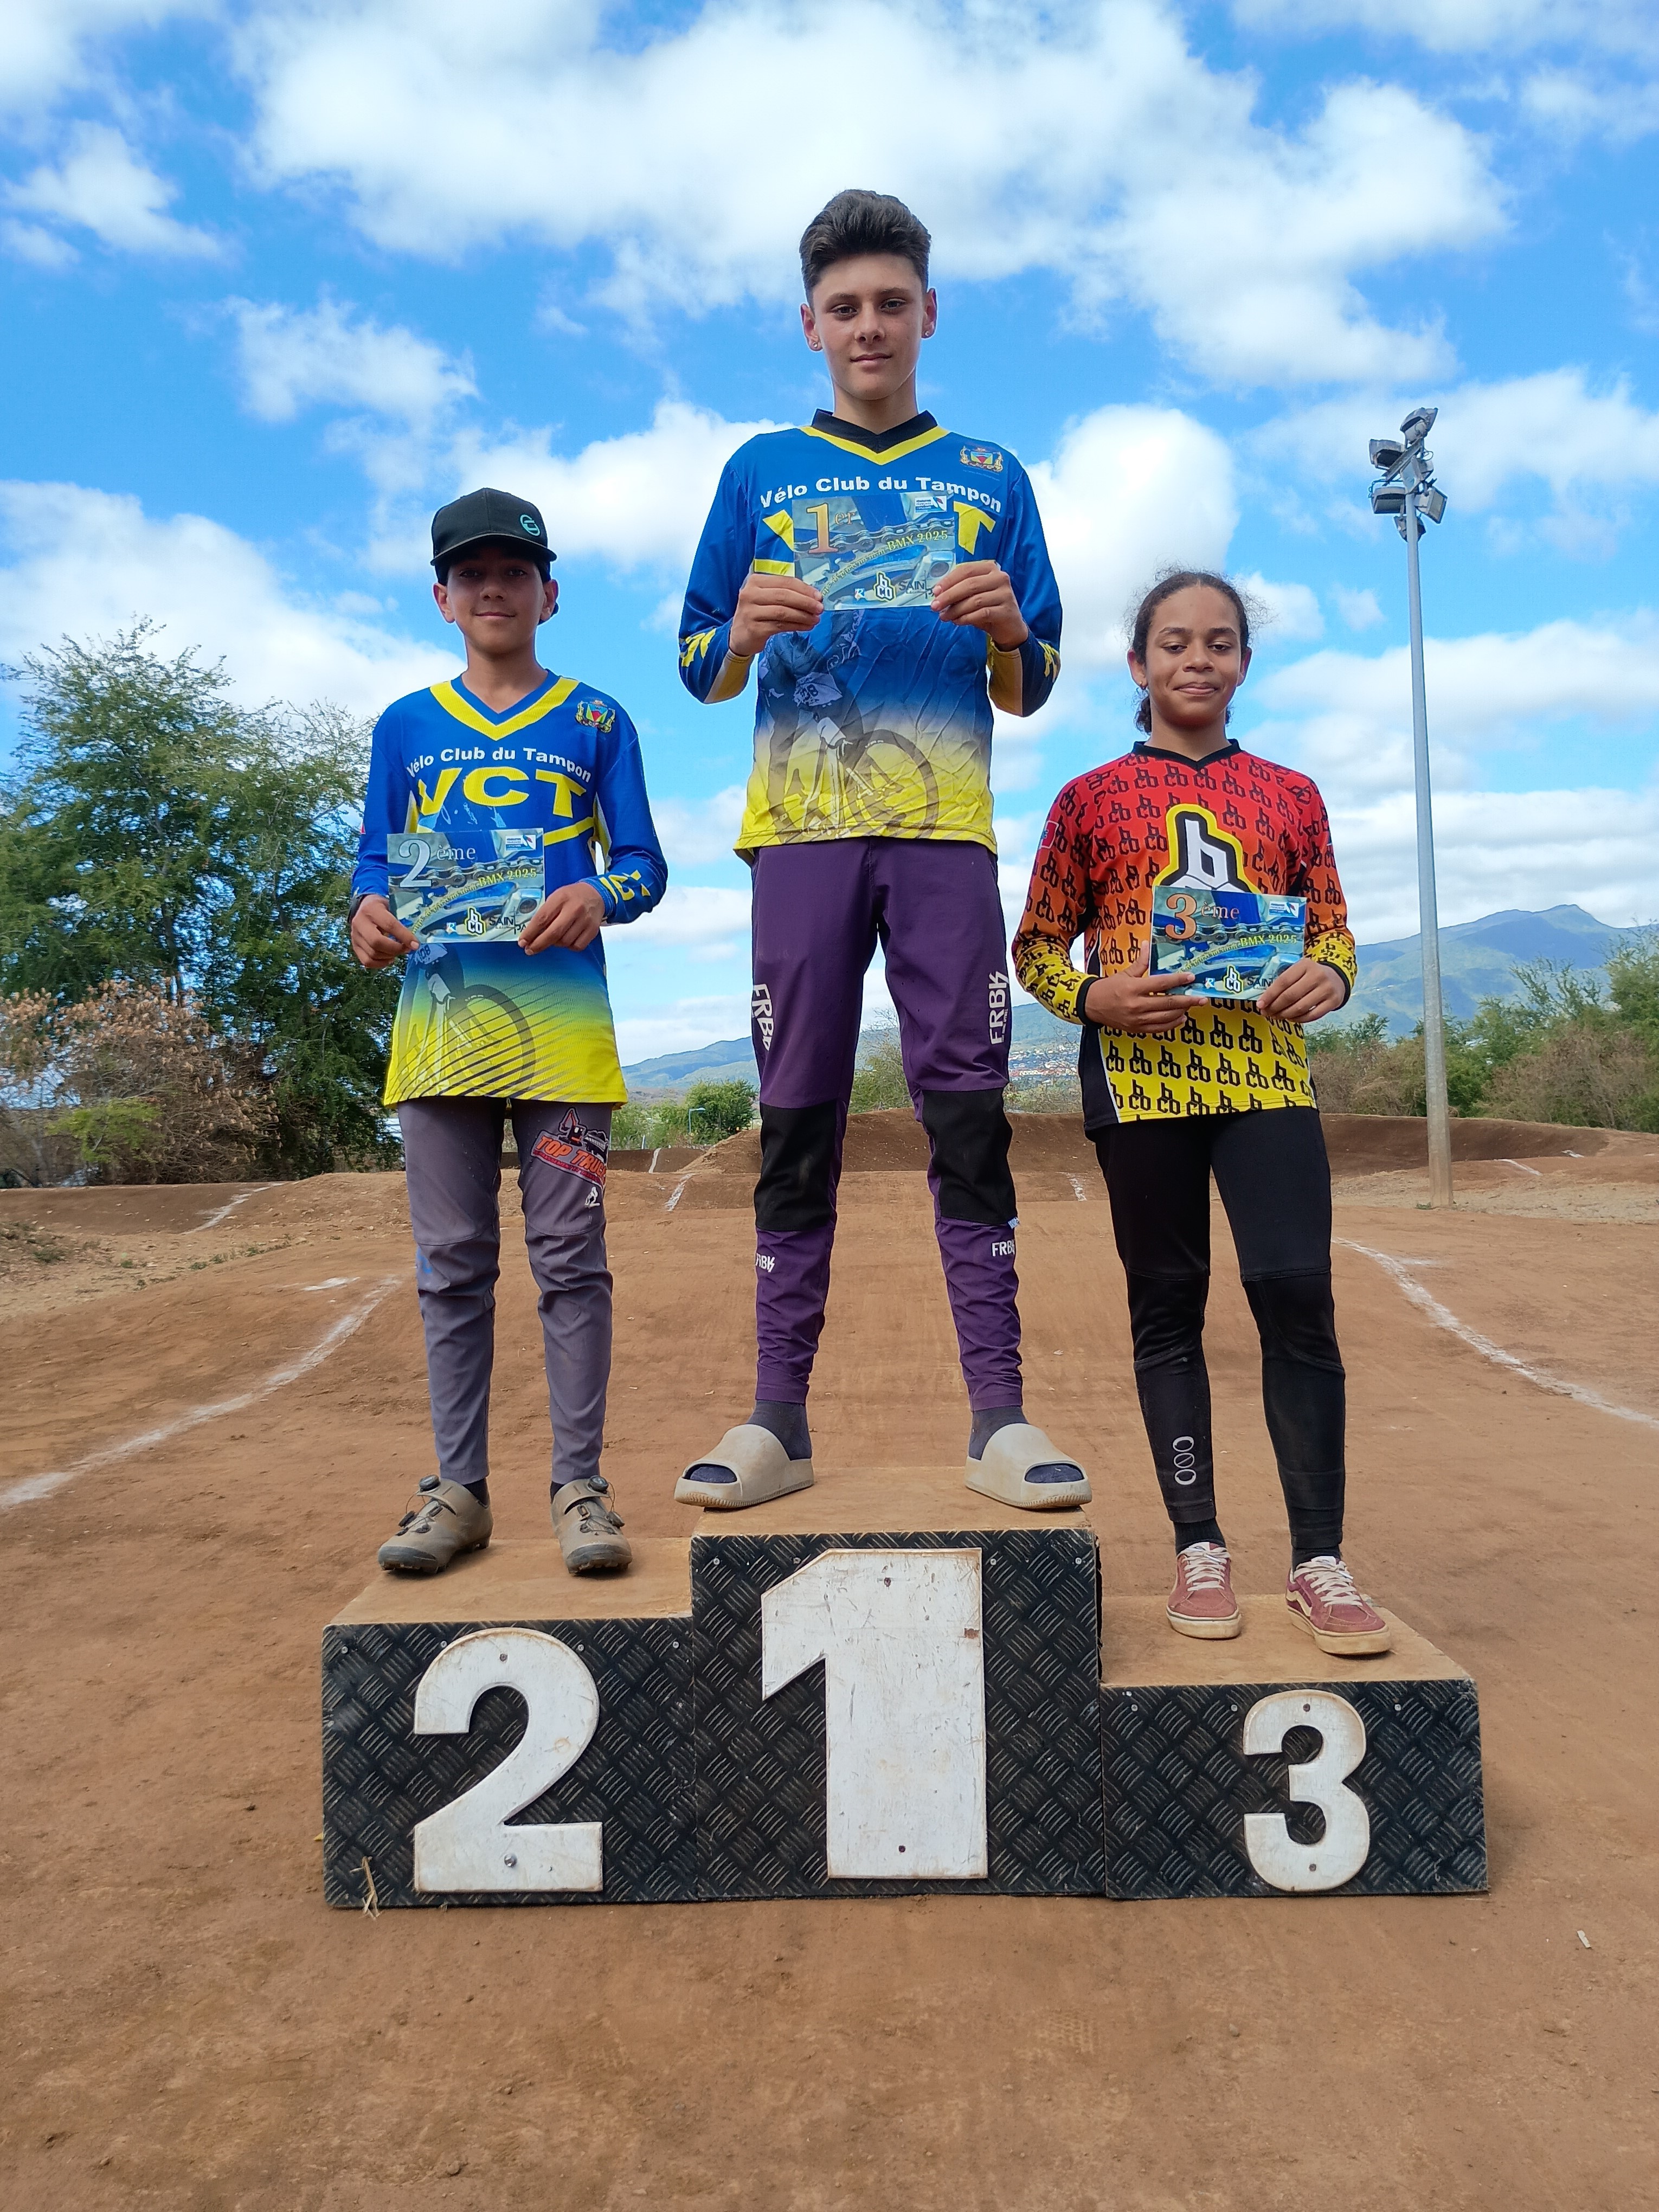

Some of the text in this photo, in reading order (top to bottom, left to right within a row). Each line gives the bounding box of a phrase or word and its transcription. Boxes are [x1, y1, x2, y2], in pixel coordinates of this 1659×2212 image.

[761, 484, 808, 509] Vélo
[815, 477, 870, 492] Club
[878, 477, 907, 491] du
[916, 477, 1001, 513] Tampon
[887, 530, 948, 551] BMX 2025
[407, 747, 591, 783] Vélo Club du Tampon
[418, 766, 586, 818] VCT
[478, 868, 537, 886] BMX 2025
[1240, 934, 1297, 947] BMX 2025
[536, 1135, 573, 1158] TOP
[570, 1149, 606, 1181] TRUC
[761, 1546, 989, 1880] 1
[413, 1626, 605, 1893] 2
[1243, 1689, 1371, 1893] 3
